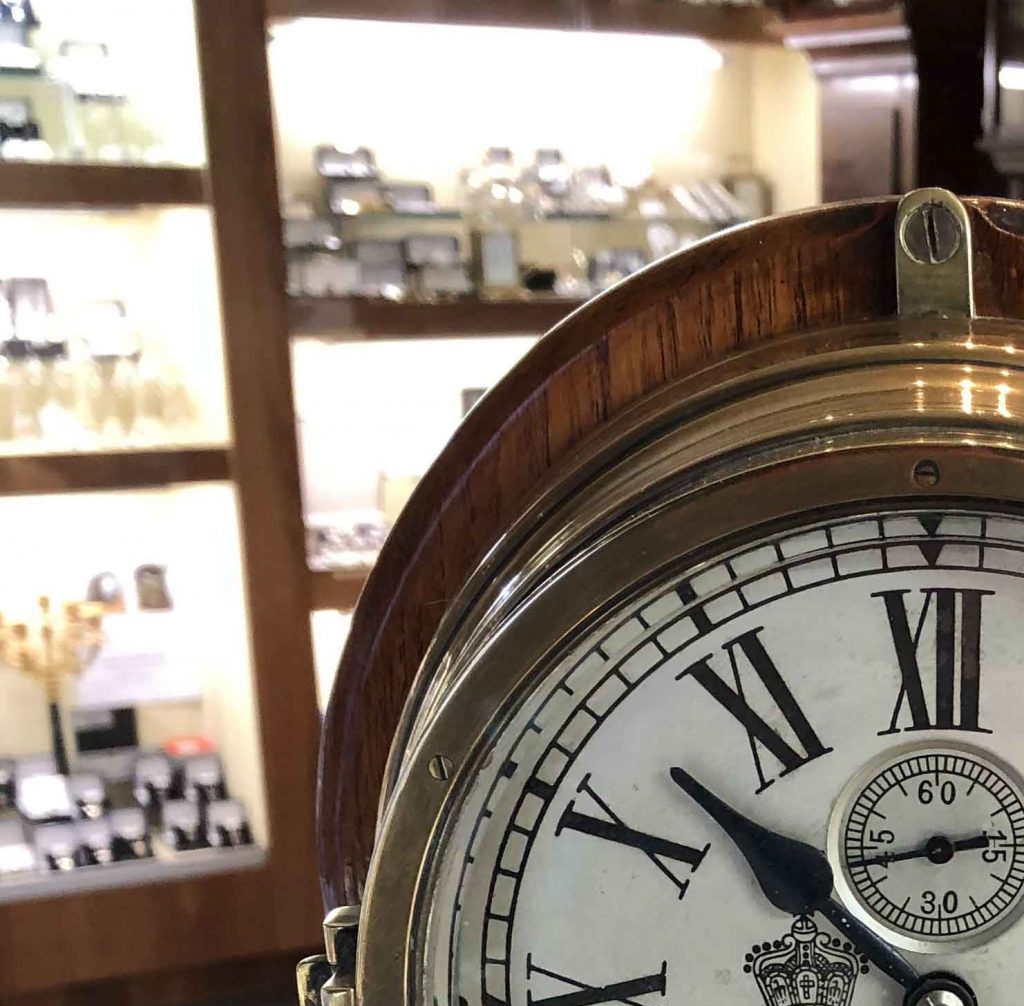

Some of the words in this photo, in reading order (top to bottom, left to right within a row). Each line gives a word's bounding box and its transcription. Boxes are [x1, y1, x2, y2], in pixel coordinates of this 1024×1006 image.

[870, 588, 995, 735] XII
[675, 626, 833, 794] XI
[918, 780, 956, 805] 60
[555, 773, 711, 900] X
[869, 829, 896, 869] 45
[981, 829, 1008, 864] 15
[920, 890, 958, 914] 30
